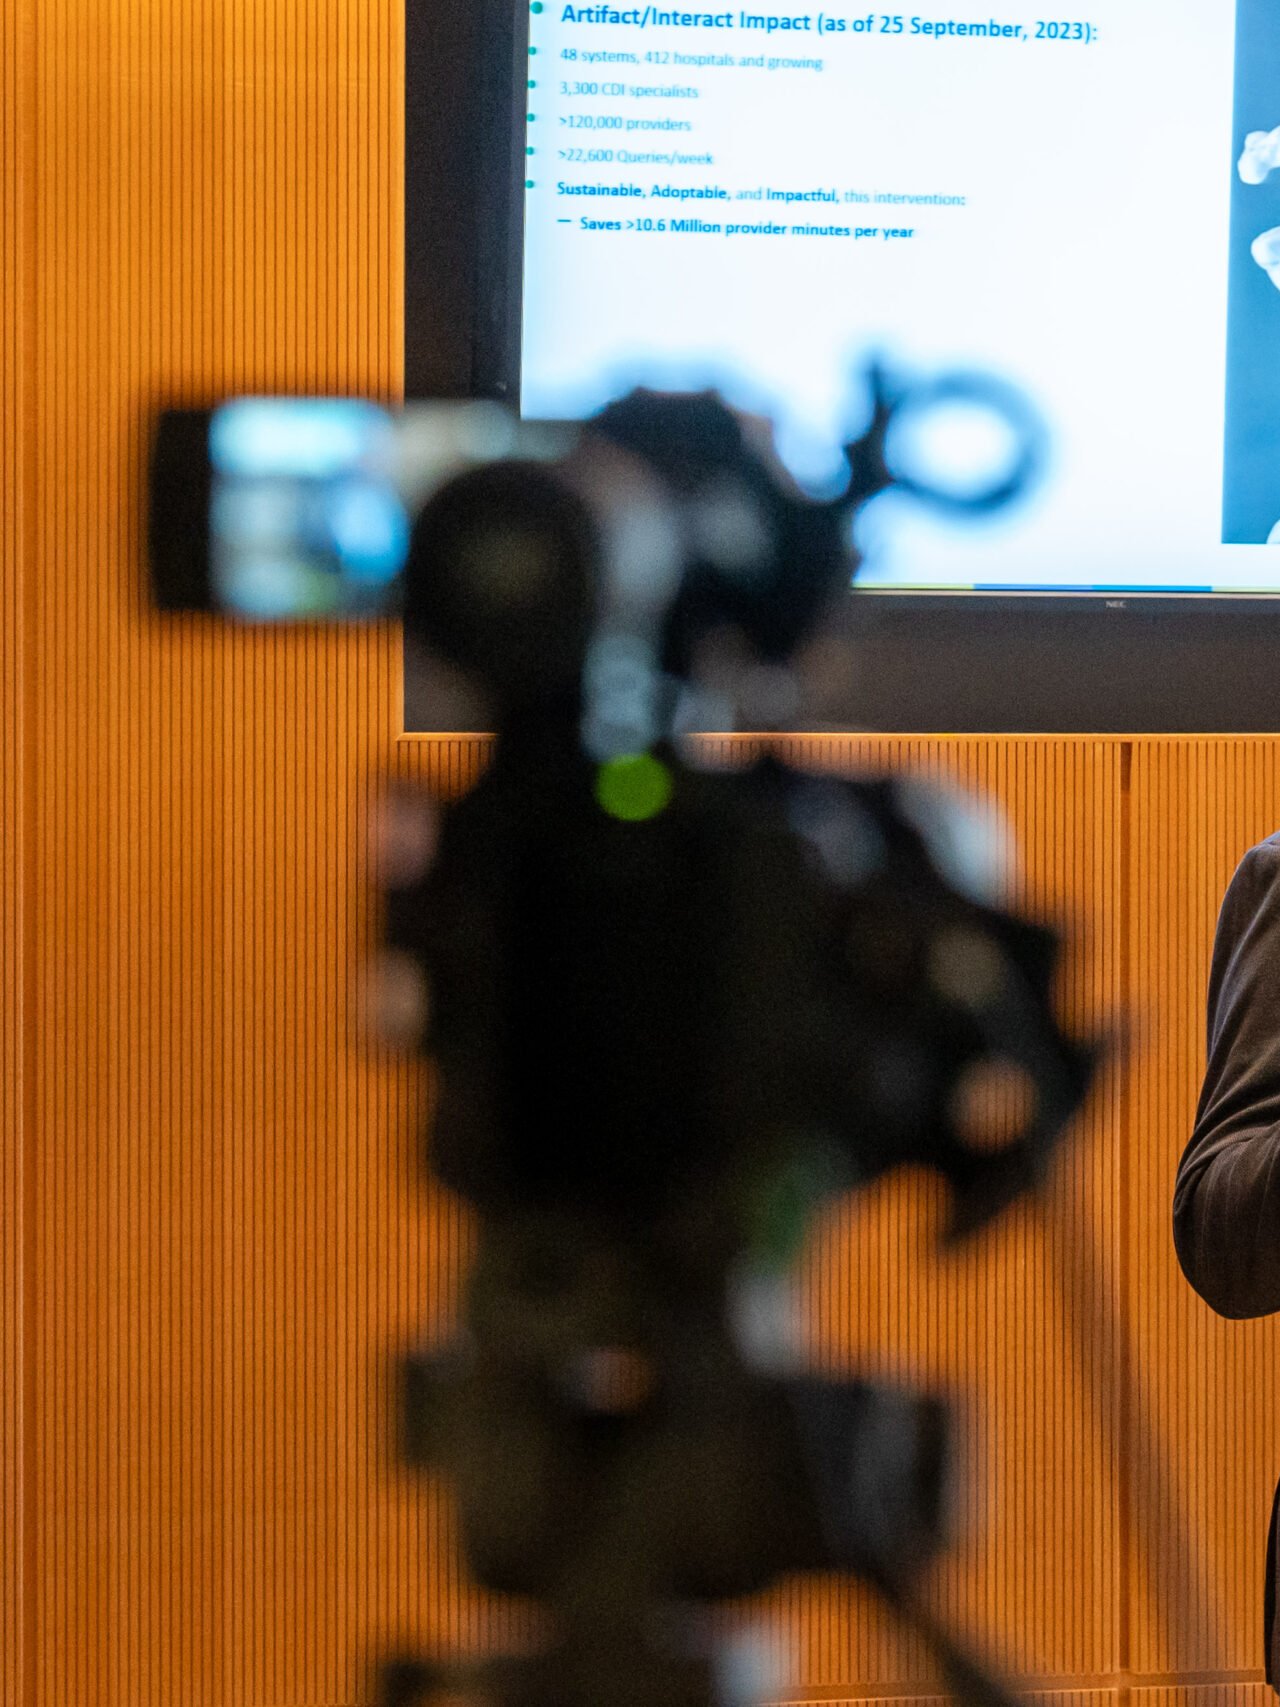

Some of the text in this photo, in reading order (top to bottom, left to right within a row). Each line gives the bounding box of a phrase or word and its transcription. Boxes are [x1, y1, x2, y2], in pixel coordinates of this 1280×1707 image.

[560, 4, 1028, 41] Artifact/Interact Impact (as of 25 September,
[560, 21, 1097, 68] 2023): 48 systems, 412 hospitals and
[560, 58, 824, 96] growing 3,300 CDI
[558, 85, 699, 130] specialists >120,000
[557, 118, 692, 163] providers >22,600
[556, 150, 871, 204] Queries/week Sustainable, Adoptable, and Impactful, this
[580, 193, 966, 240] intervention: Saves >10.6 Million provider minutes per
